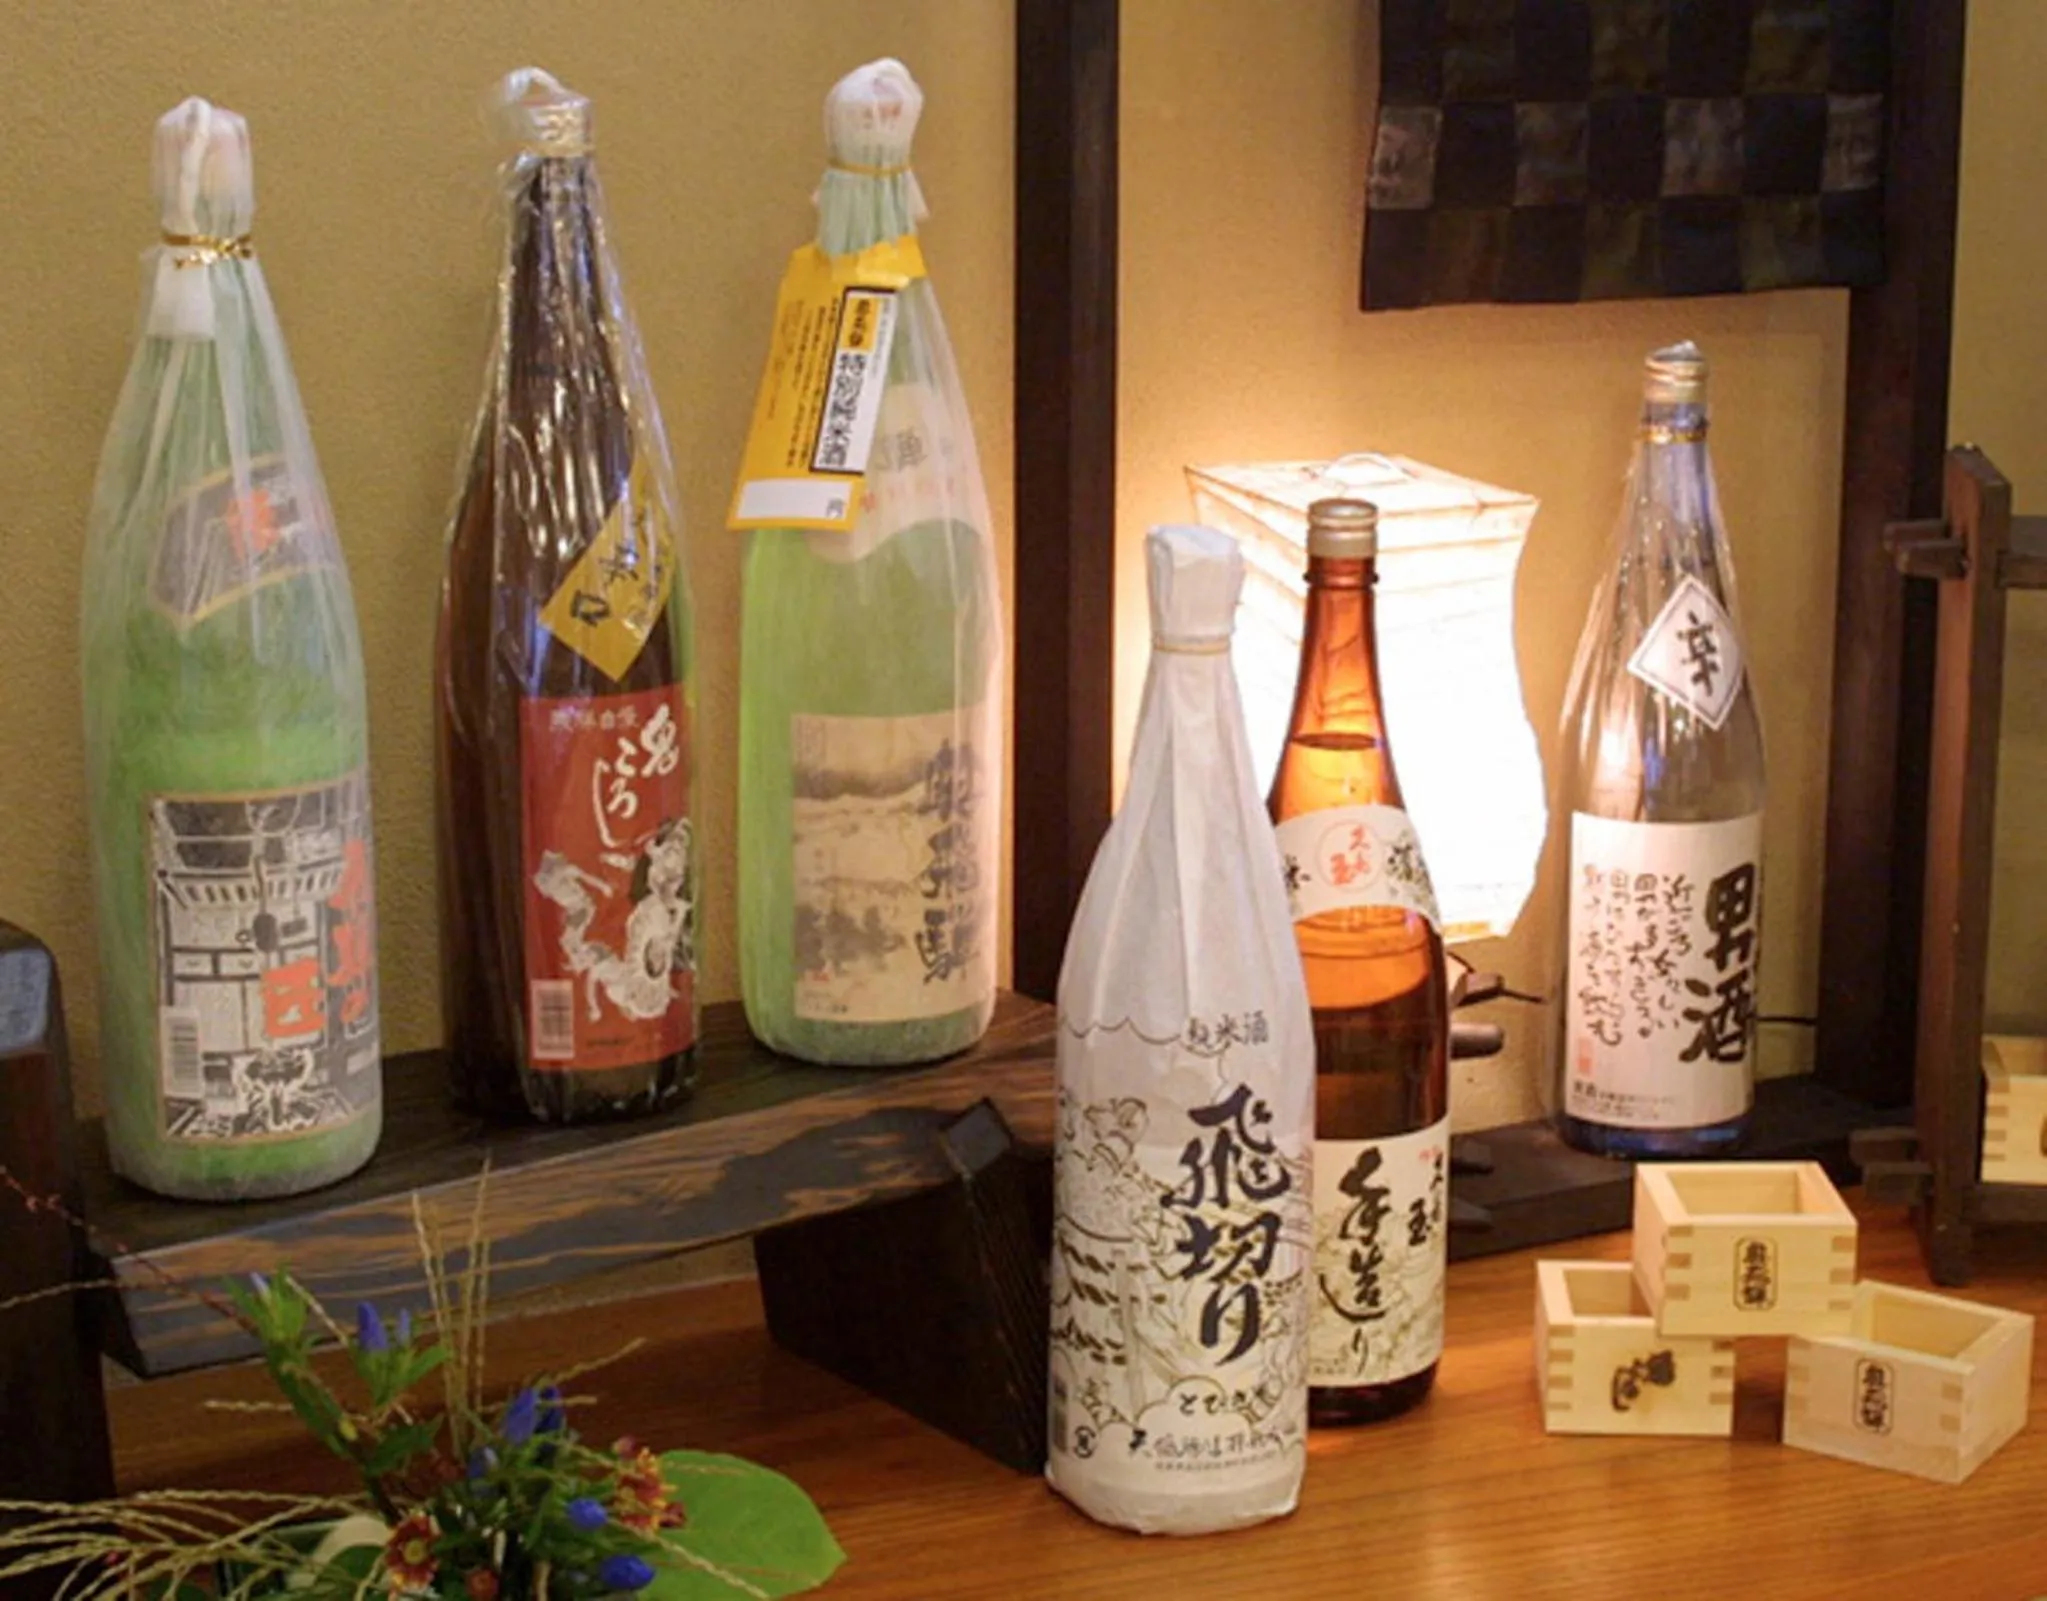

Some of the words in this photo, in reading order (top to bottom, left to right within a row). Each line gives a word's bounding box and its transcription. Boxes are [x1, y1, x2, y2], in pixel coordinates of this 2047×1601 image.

[593, 702, 681, 848] 鬼ころし
[1188, 1009, 1270, 1047] 純米酒
[1679, 863, 1755, 1064] 男酒
[1158, 1083, 1291, 1367] 飛切り
[1319, 1146, 1391, 1378] 手造り
